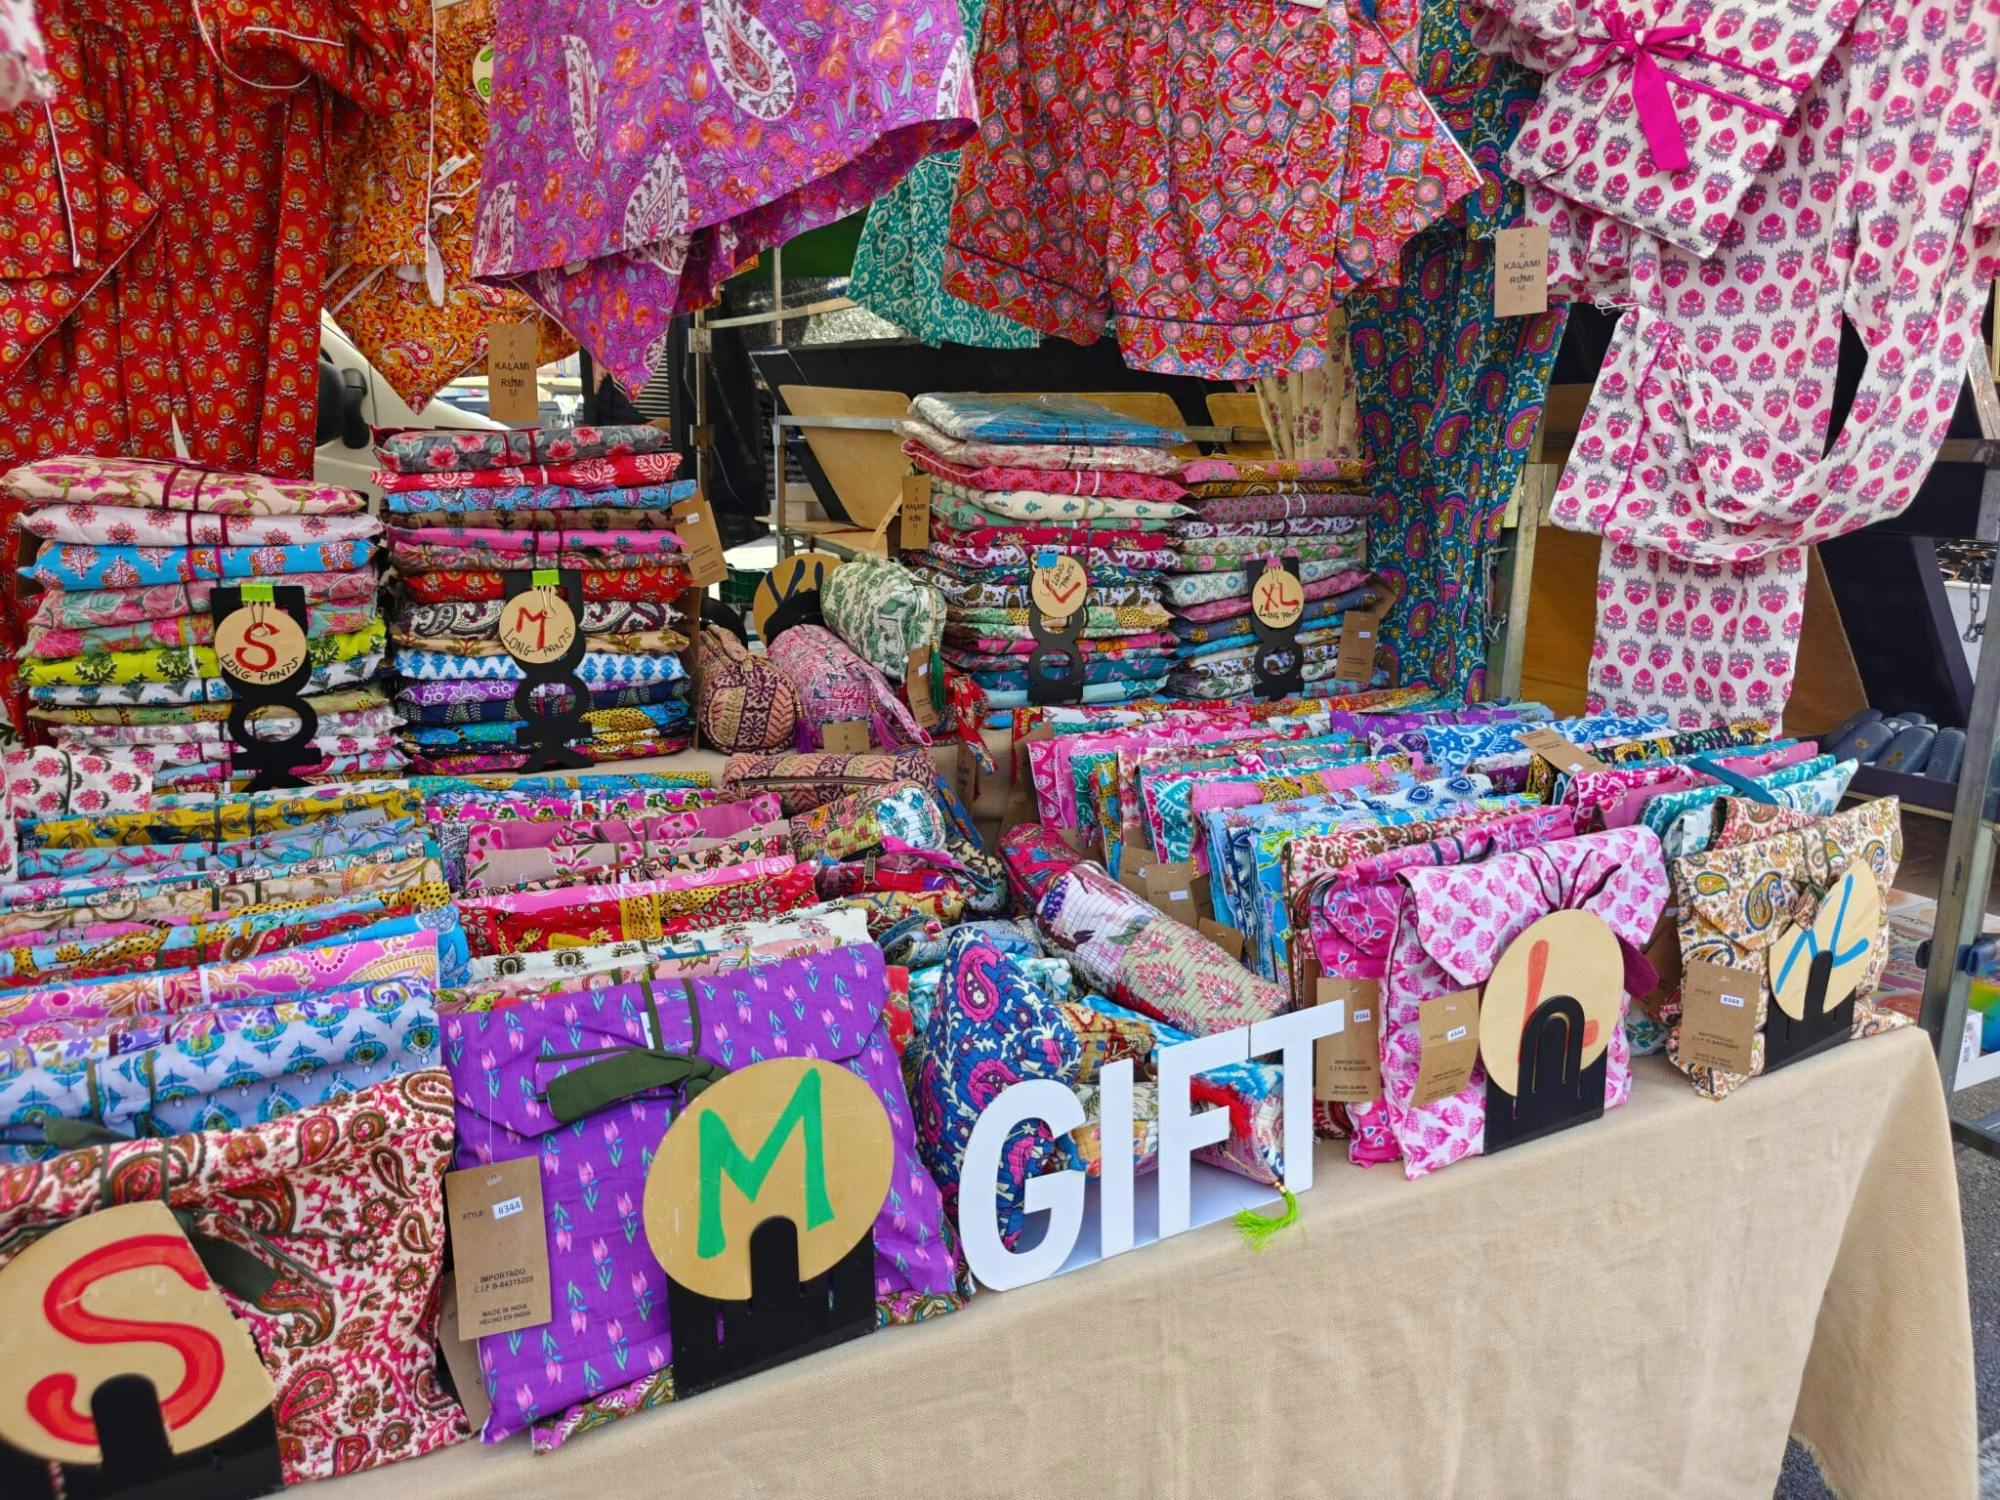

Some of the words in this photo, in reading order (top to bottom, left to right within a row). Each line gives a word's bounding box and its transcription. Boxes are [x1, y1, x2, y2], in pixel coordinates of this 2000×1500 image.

[1504, 260, 1541, 270] KALAMI
[1510, 274, 1534, 284] RUMI
[494, 361, 530, 371] KALAMI
[501, 378, 525, 388] RUMI
[1261, 582, 1300, 612] XL
[503, 627, 535, 656] LONG
[543, 626, 572, 656] PANTS
[516, 607, 549, 650] M
[235, 622, 280, 672] S
[220, 653, 251, 679] LONG
[260, 656, 299, 681] PANTS
[957, 999, 1345, 1292] GIFT
[697, 1067, 835, 1259] M
[480, 1267, 526, 1284] IMPORTADO
[482, 1308, 501, 1317] MADE
[26, 1233, 225, 1447] S
